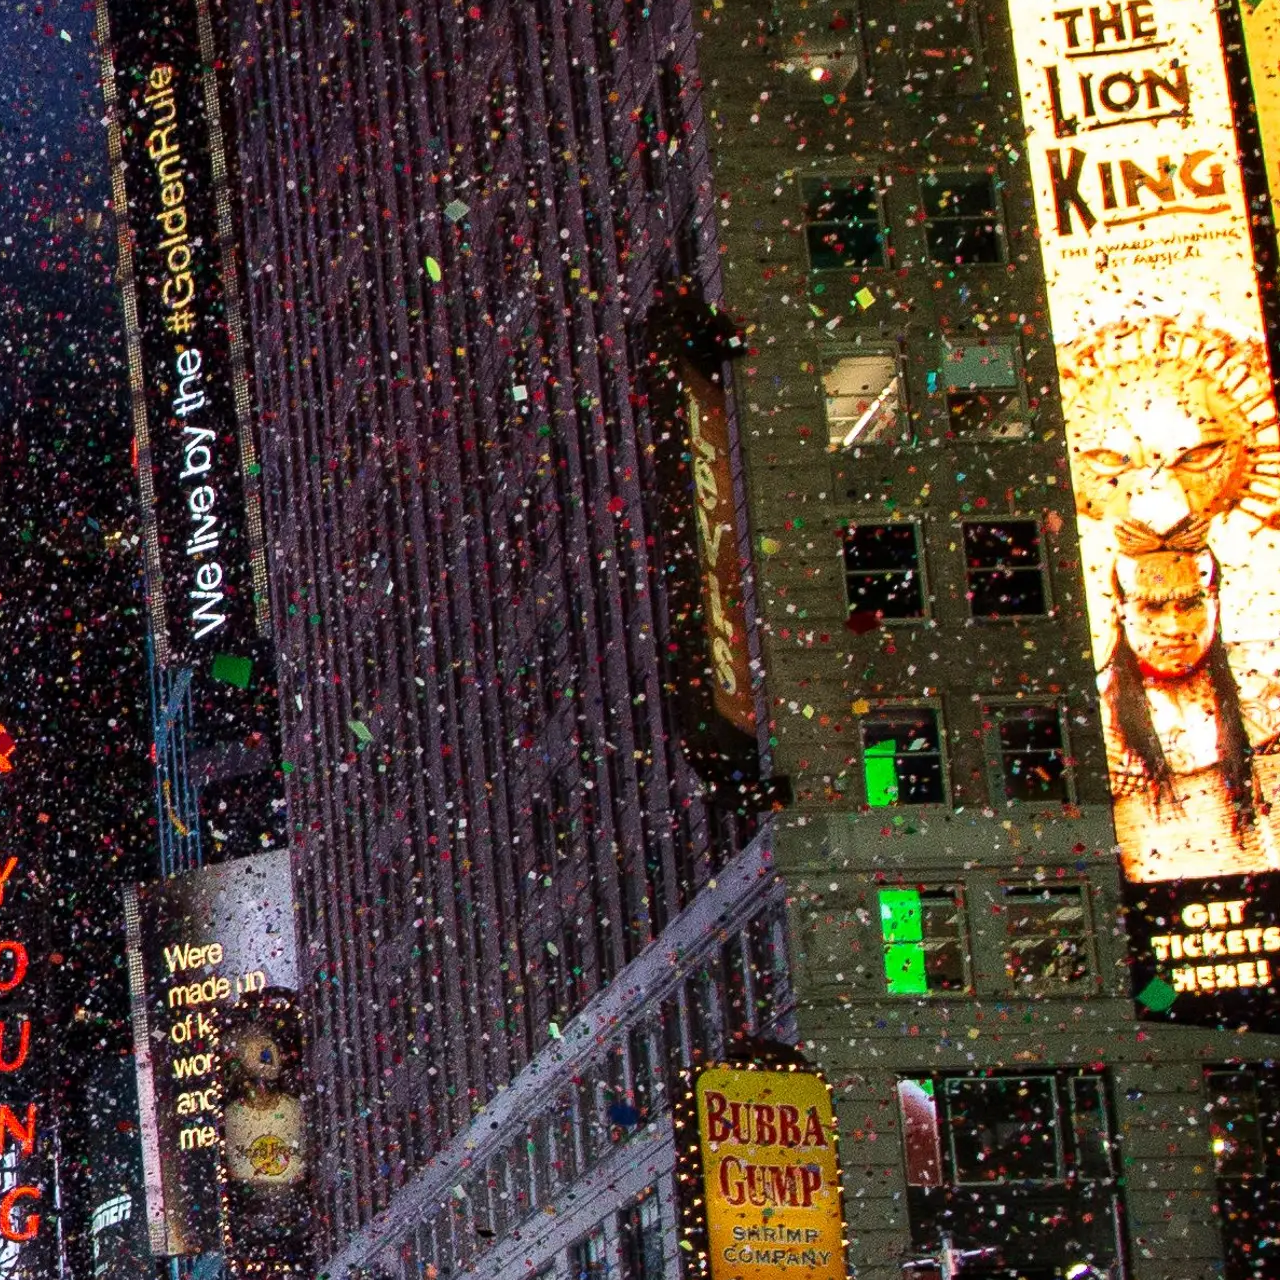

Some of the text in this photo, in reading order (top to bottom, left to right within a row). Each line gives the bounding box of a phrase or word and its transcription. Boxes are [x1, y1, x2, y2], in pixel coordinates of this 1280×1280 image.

[1042, 63, 1190, 139] LION
[1045, 147, 1228, 236] KING
[144, 61, 226, 641] We live by the #GoldenRule
[1181, 899, 1247, 928] GET
[1150, 926, 1280, 960] TICKETS
[169, 975, 230, 1009] made
[1171, 959, 1272, 993] HERE!
[703, 1089, 828, 1151] BUBBA
[718, 1154, 823, 1210] GUMP
[732, 1224, 819, 1245] SHRIMP
[723, 1245, 832, 1268] COMPANY
